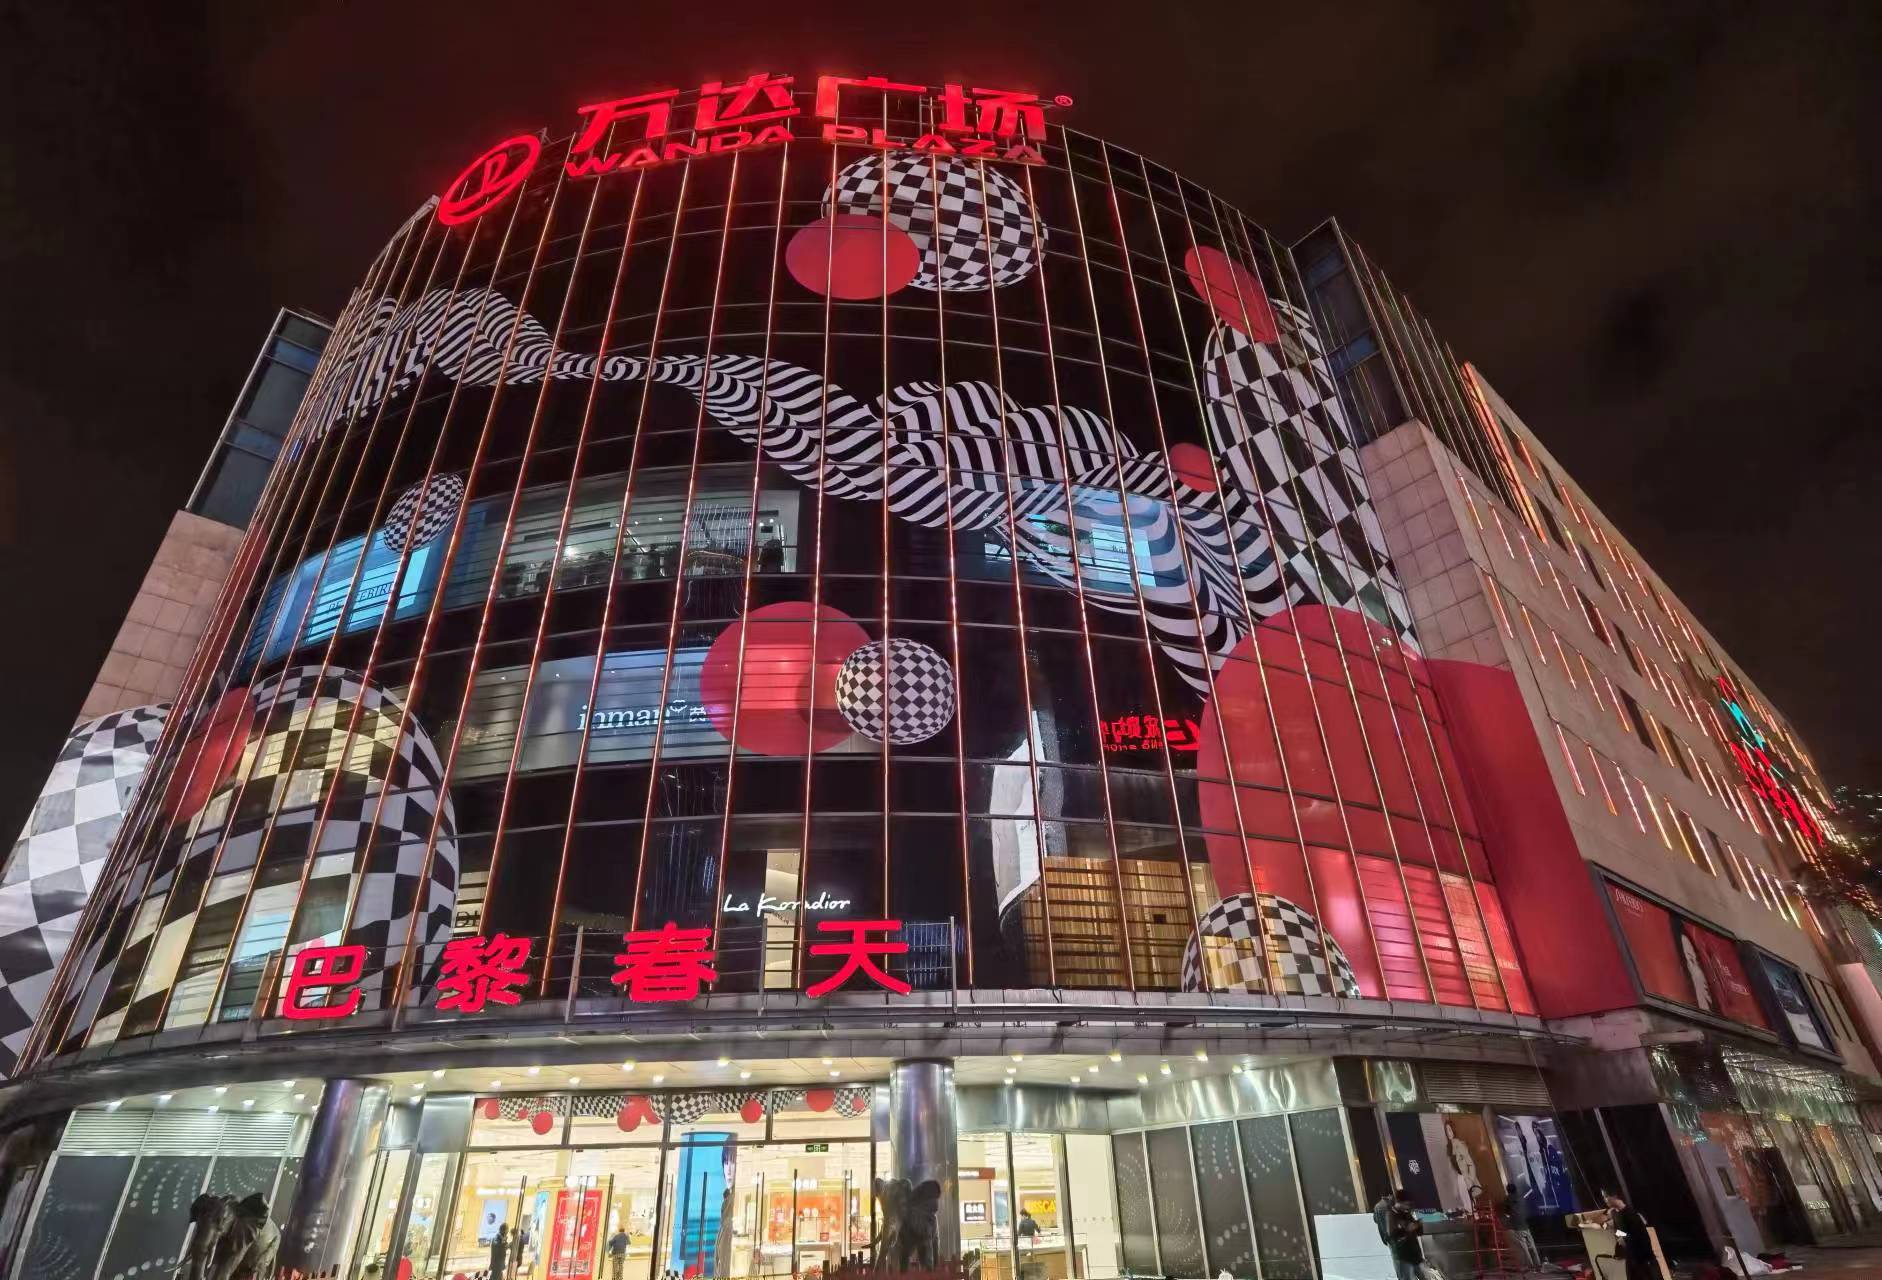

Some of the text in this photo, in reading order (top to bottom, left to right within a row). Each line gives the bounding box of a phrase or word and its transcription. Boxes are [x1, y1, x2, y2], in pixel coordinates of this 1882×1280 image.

[571, 72, 1047, 154] 万达广场
[565, 124, 1047, 176] WANDA PLAZA
[723, 894, 750, 912] La
[282, 920, 912, 1020] 巴黎春天
